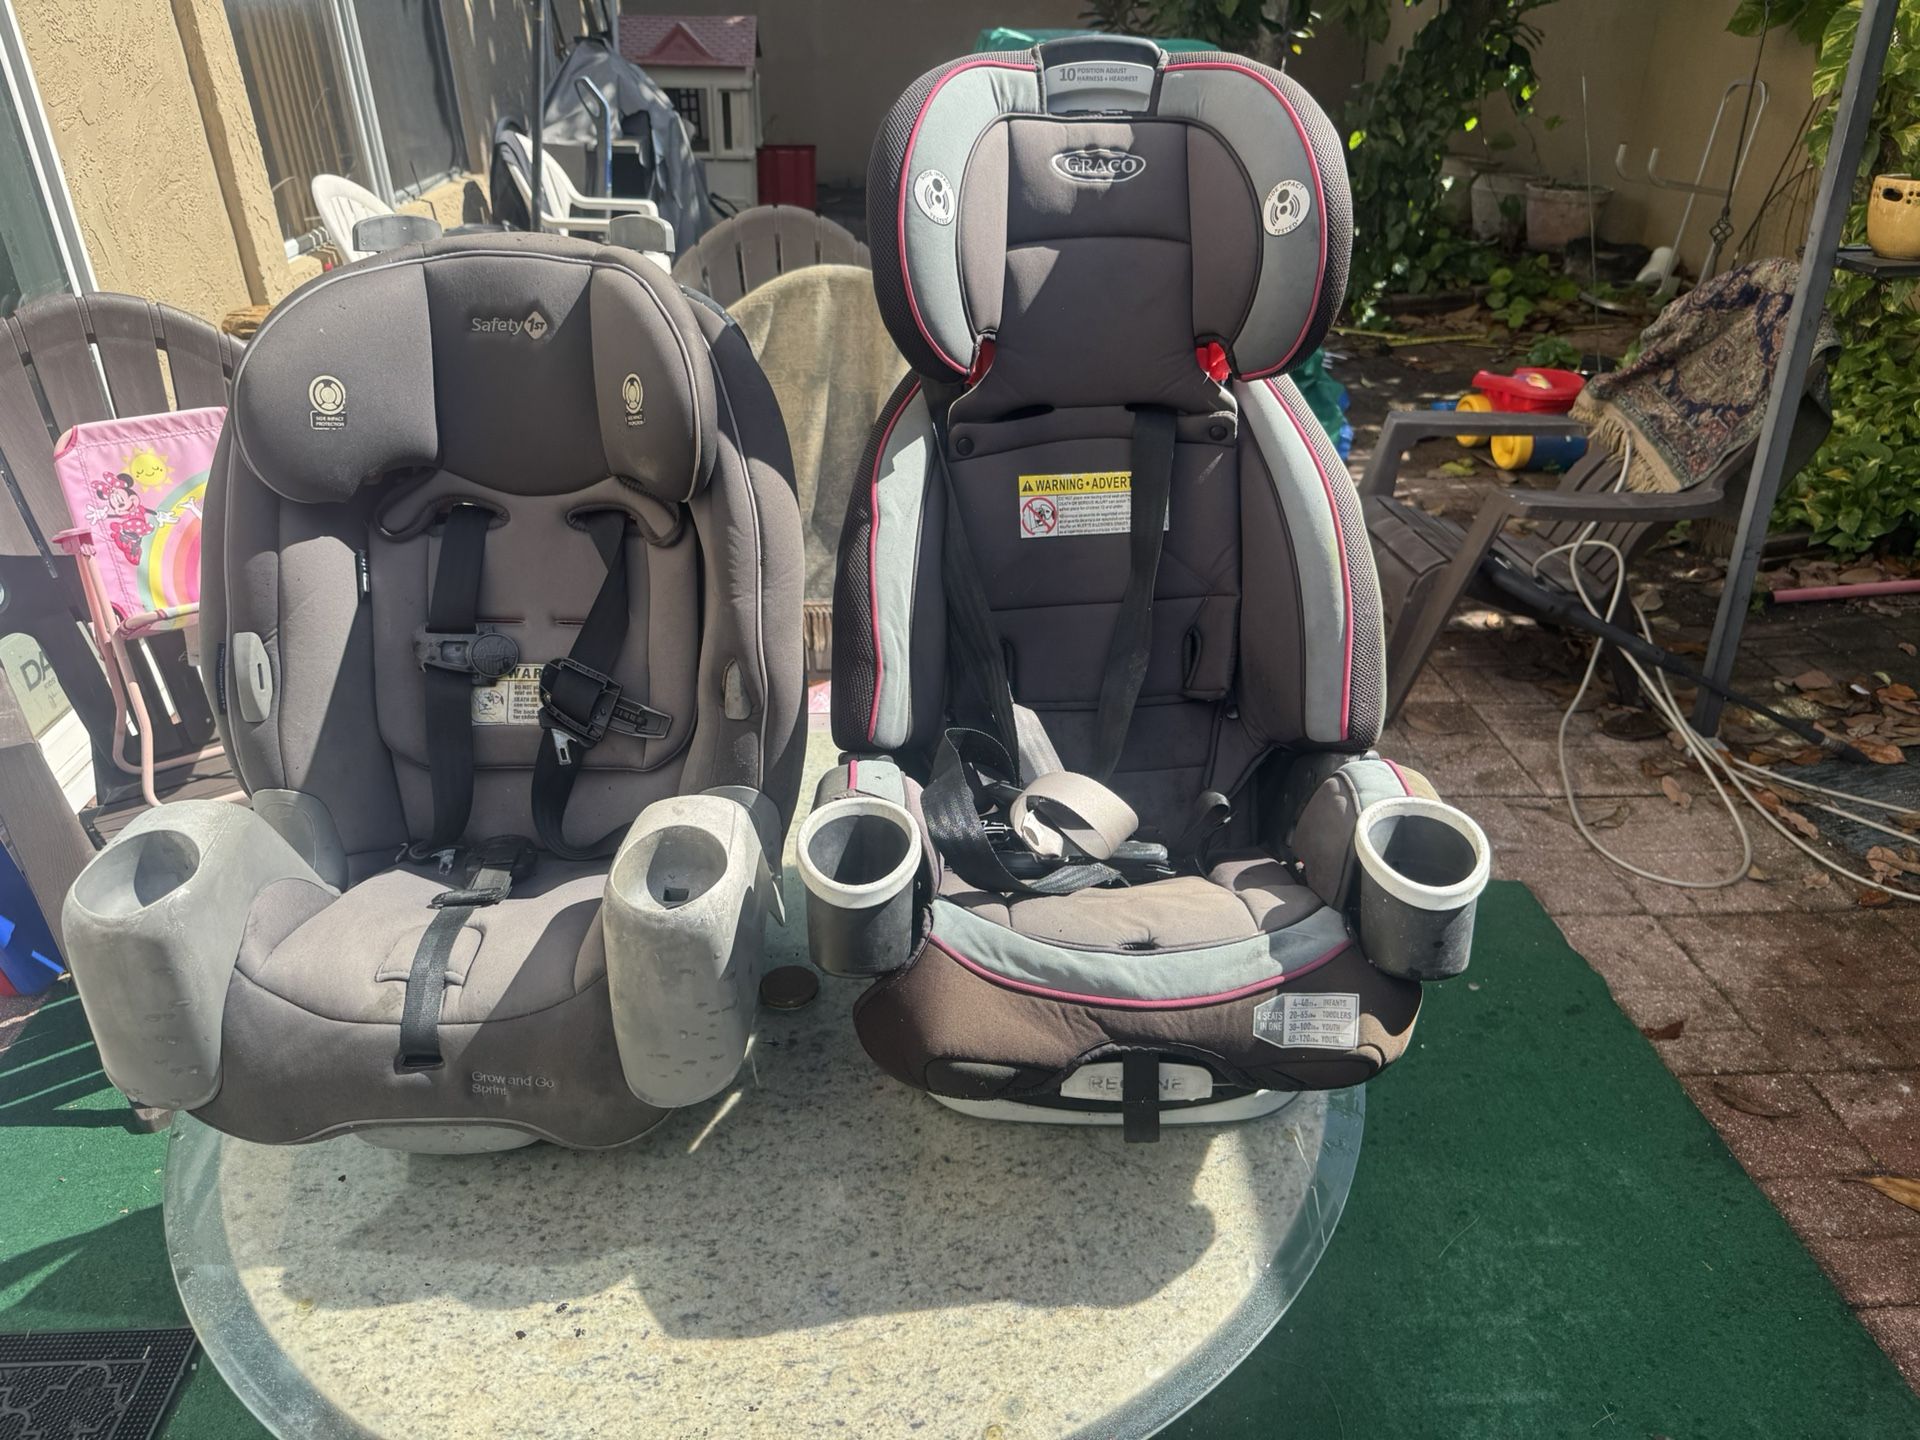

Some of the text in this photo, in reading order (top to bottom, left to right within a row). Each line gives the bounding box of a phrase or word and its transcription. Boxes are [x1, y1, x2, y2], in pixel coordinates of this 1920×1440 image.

[1060, 68, 1076, 81] 10
[1064, 156, 1137, 173] GRACO
[471, 317, 524, 335] Safety
[1035, 478, 1083, 491] WARNING
[1262, 1011, 1283, 1021] SEATS
[1268, 1021, 1282, 1031] ONE
[1322, 1023, 1340, 1031] YOUTH
[471, 1071, 555, 1088] Grow and Go
[472, 1083, 507, 1096] Sprint
